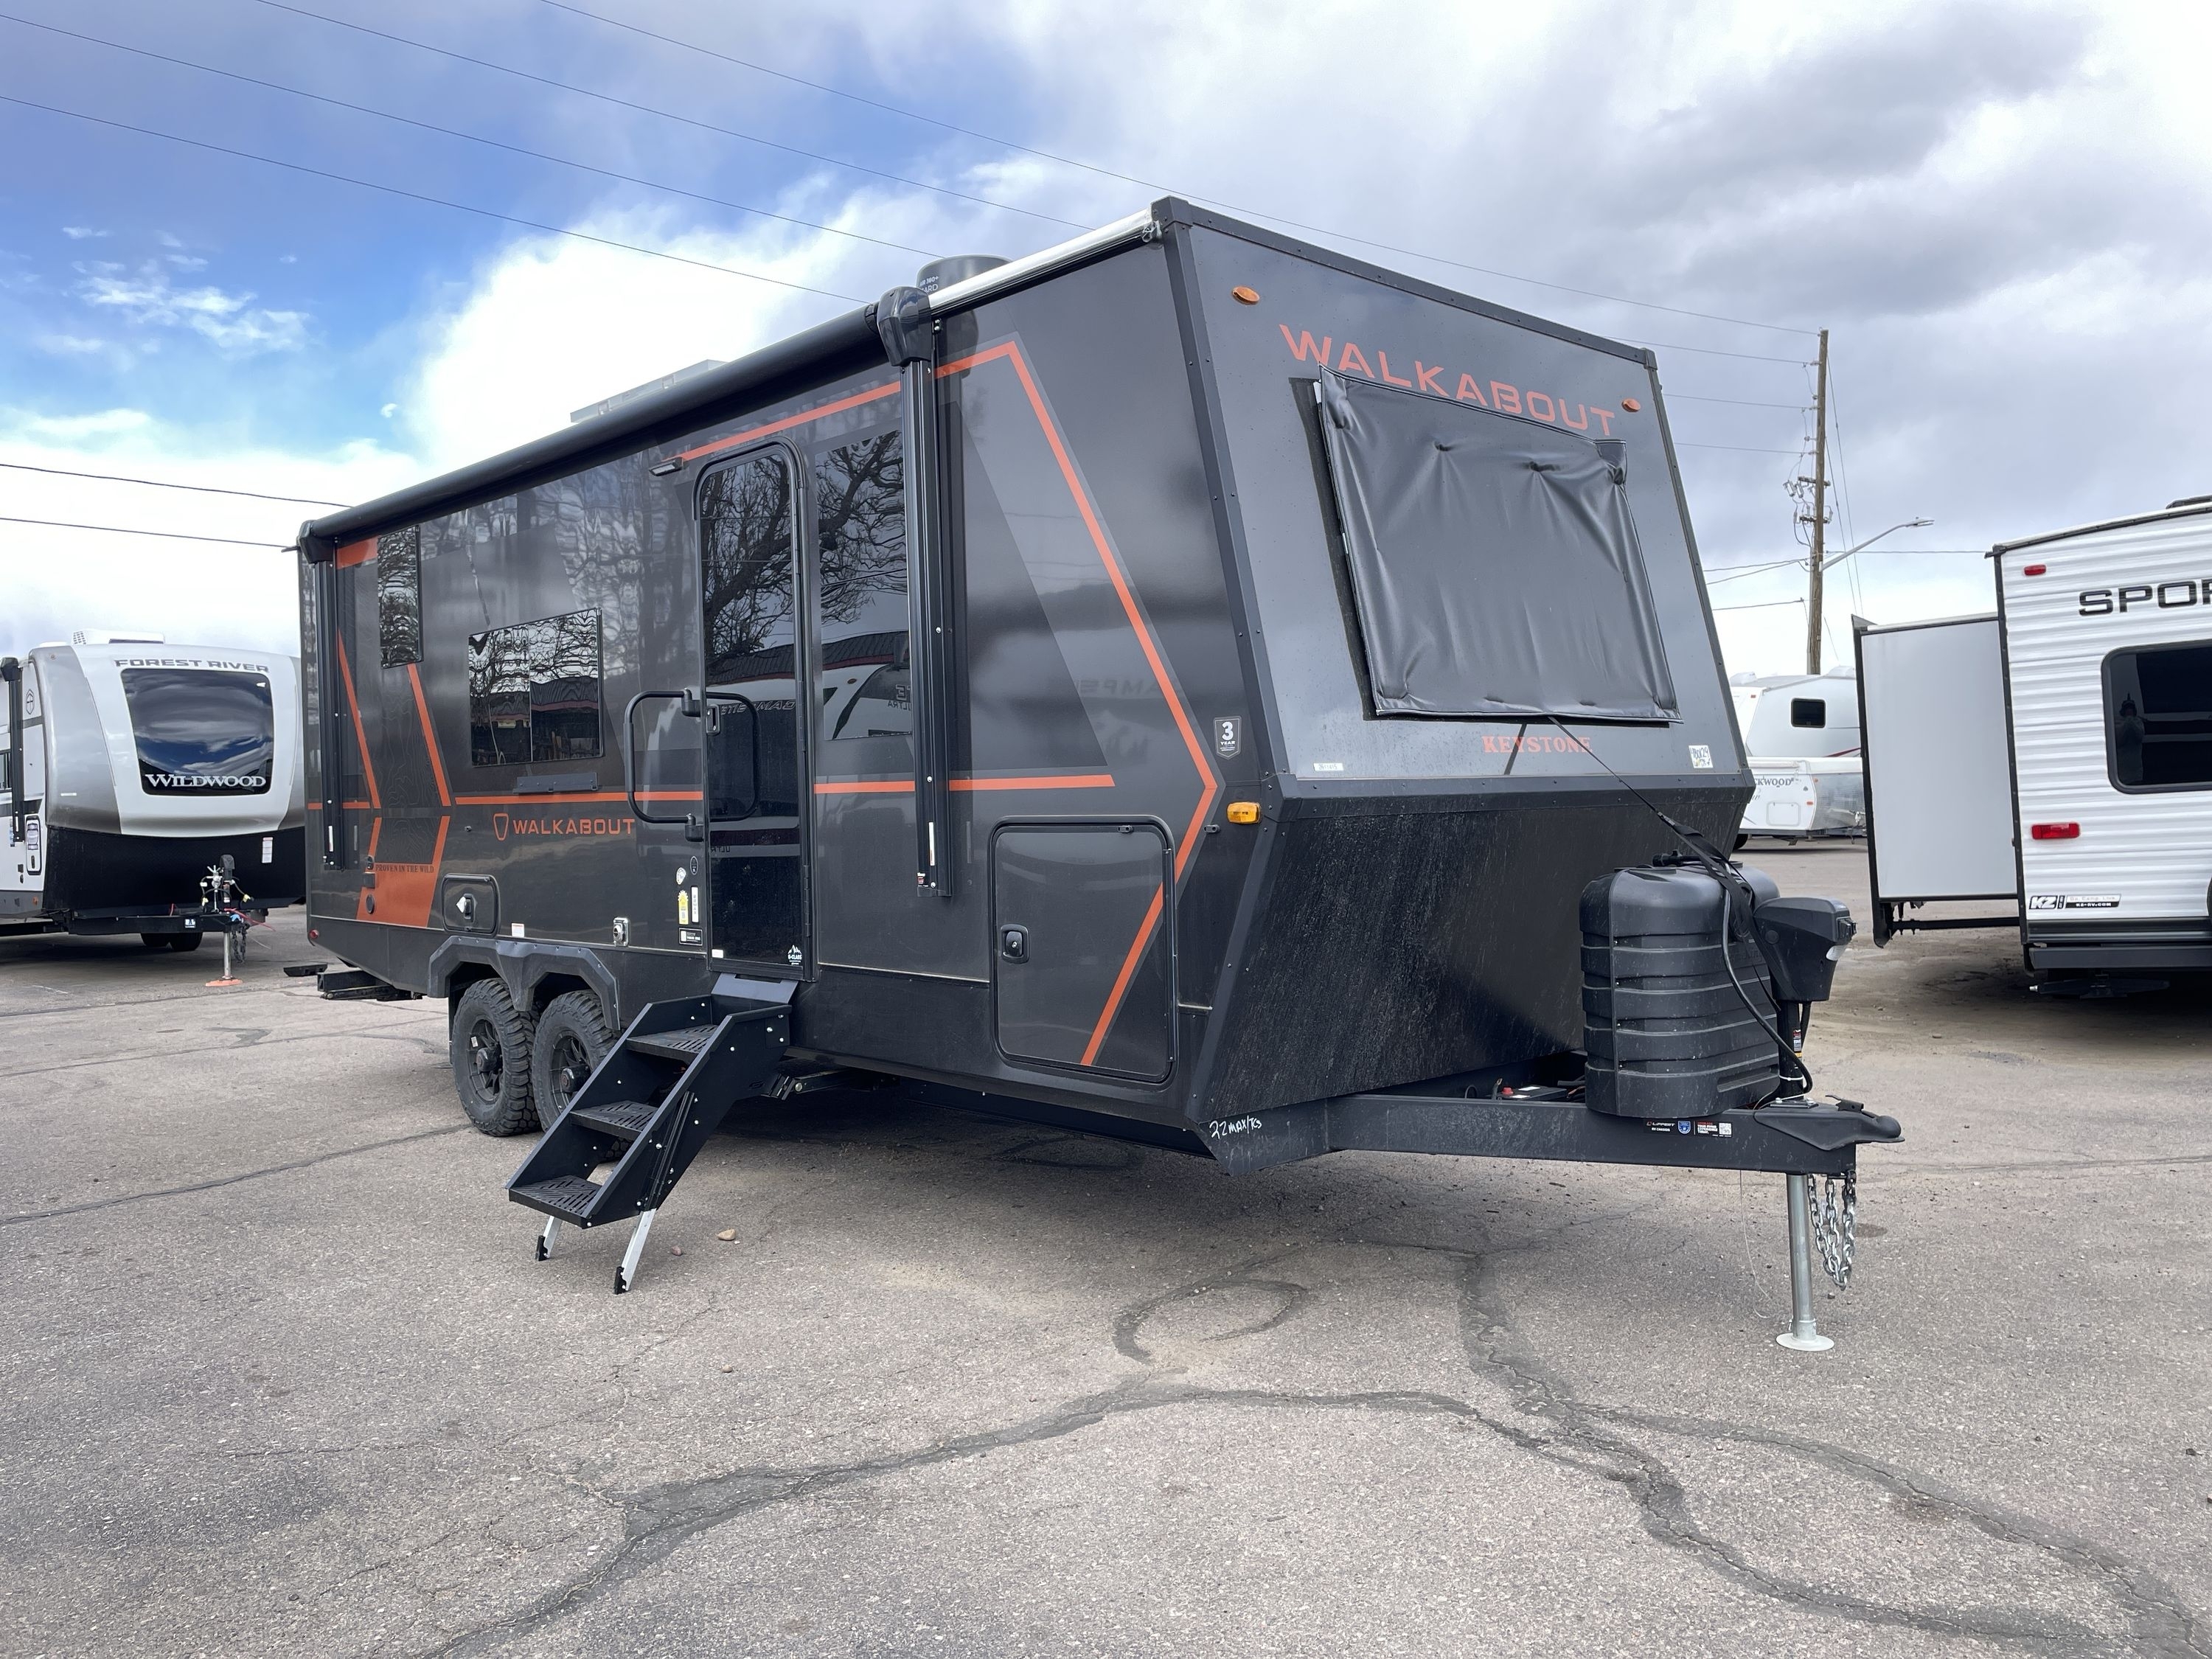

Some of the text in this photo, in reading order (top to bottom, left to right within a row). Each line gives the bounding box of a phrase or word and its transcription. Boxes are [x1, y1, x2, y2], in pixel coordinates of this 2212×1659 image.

[1279, 324, 1615, 436] WALKABOUT
[114, 658, 269, 672] FOREST RIVER
[1222, 721, 1234, 740] 3
[1481, 736, 1593, 753] KEYSTONE
[145, 774, 266, 787] WILDWOOD
[512, 818, 636, 835] WALKABOUT
[420, 865, 434, 873] WILD
[2030, 896, 2057, 908] KZ
